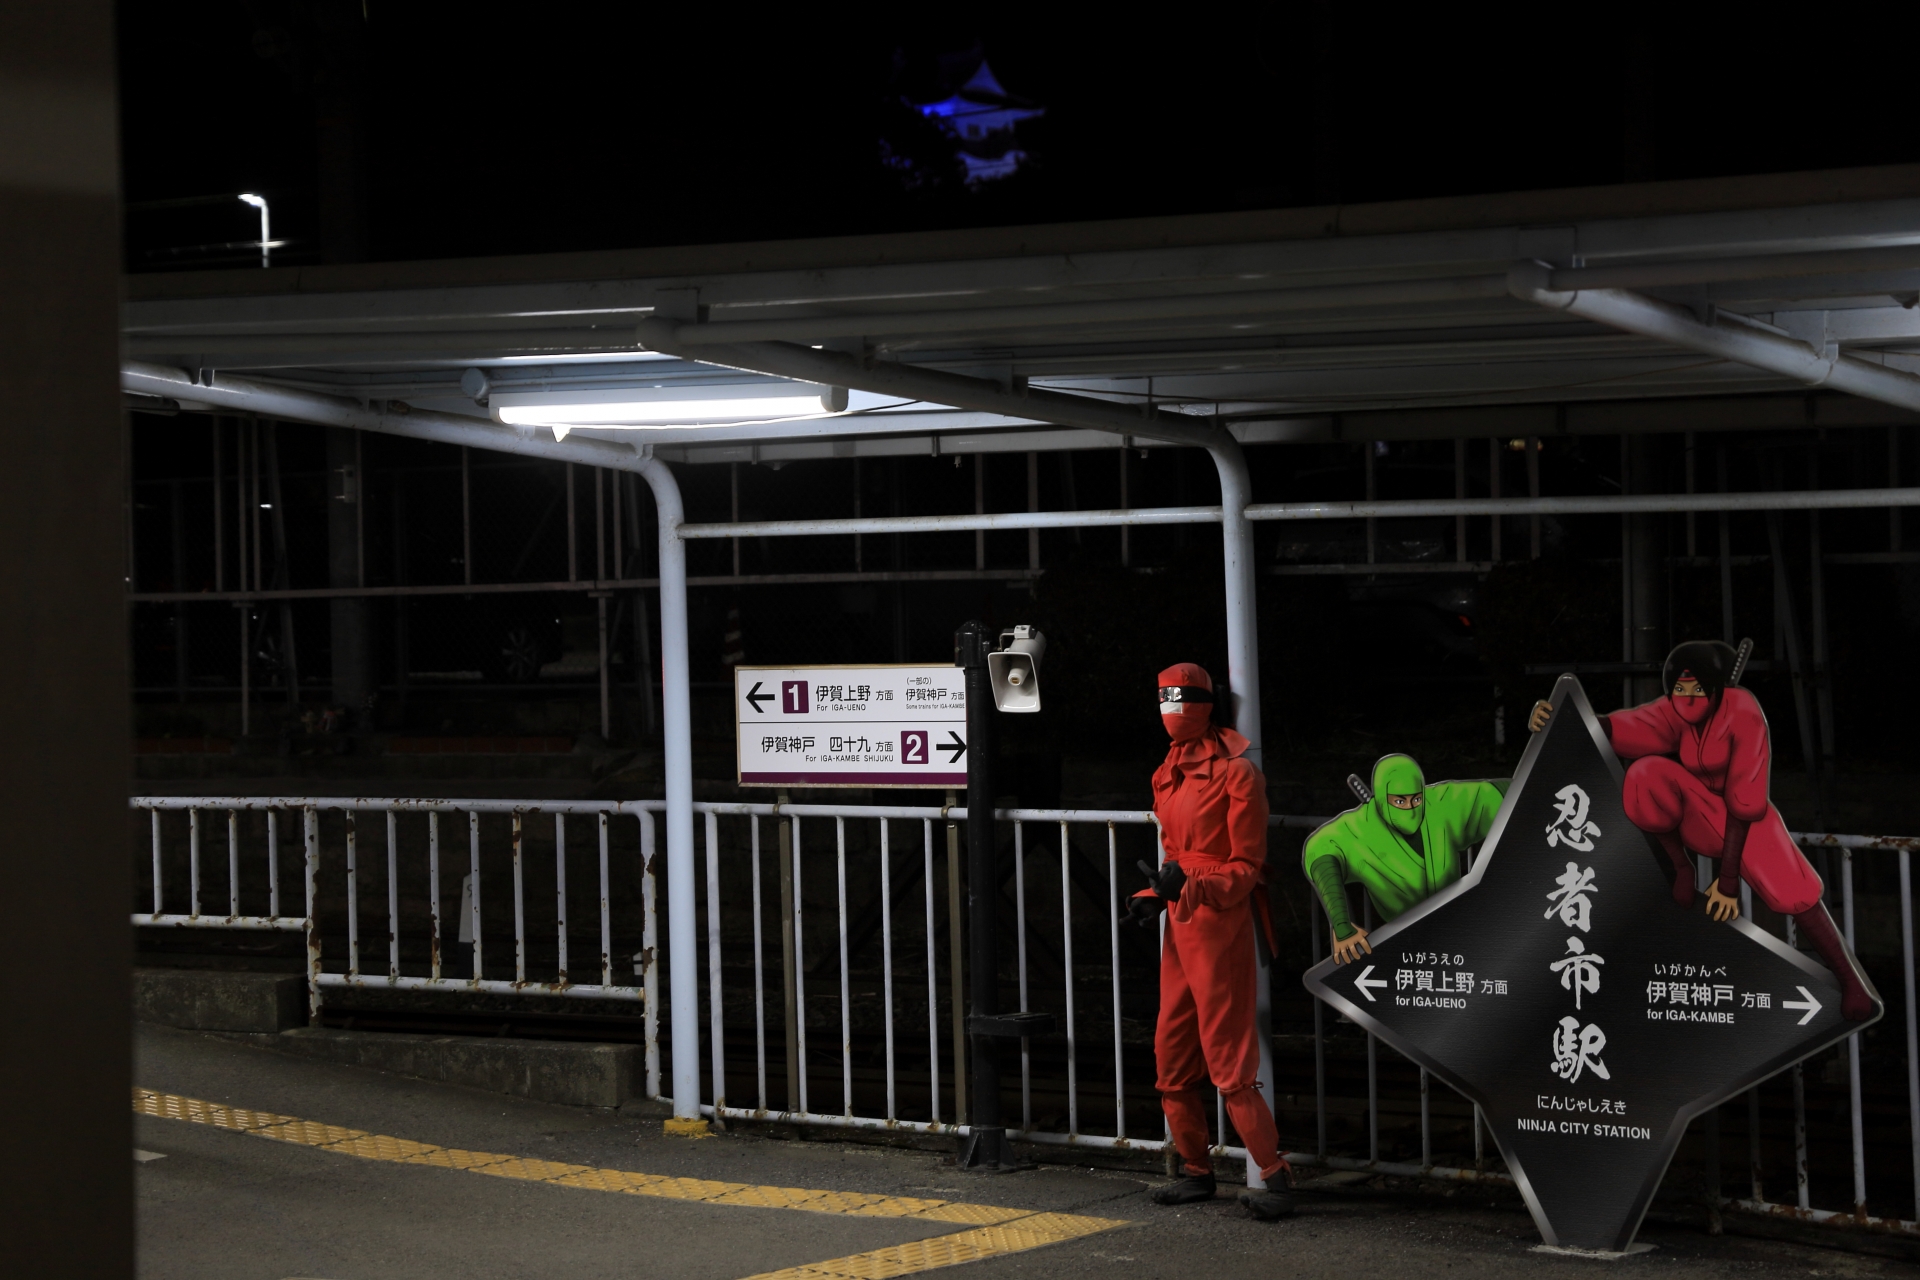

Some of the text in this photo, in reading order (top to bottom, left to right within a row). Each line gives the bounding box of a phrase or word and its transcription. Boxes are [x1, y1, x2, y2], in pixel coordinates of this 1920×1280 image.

[788, 684, 894, 711] 1 伊賀上野 方面
[905, 688, 965, 701] 伊賀神戸 方面
[761, 734, 923, 762] 伊賀神戸 四十九 方面 2
[1544, 784, 1611, 1083] 忍者市駅
[1402, 952, 1464, 966] いがうえの
[1654, 963, 1727, 977] いがかんべ
[1395, 969, 1508, 995] 伊賀上野 方面
[1395, 996, 1467, 1009] for IGA-UENO
[1646, 980, 1771, 1009] 伊賀神戸 方面
[1646, 1008, 1735, 1024] for IGA-KAMBE
[1537, 1094, 1627, 1115] にんじゃしえき
[1517, 1118, 1651, 1140] NINJA CITY STATION
